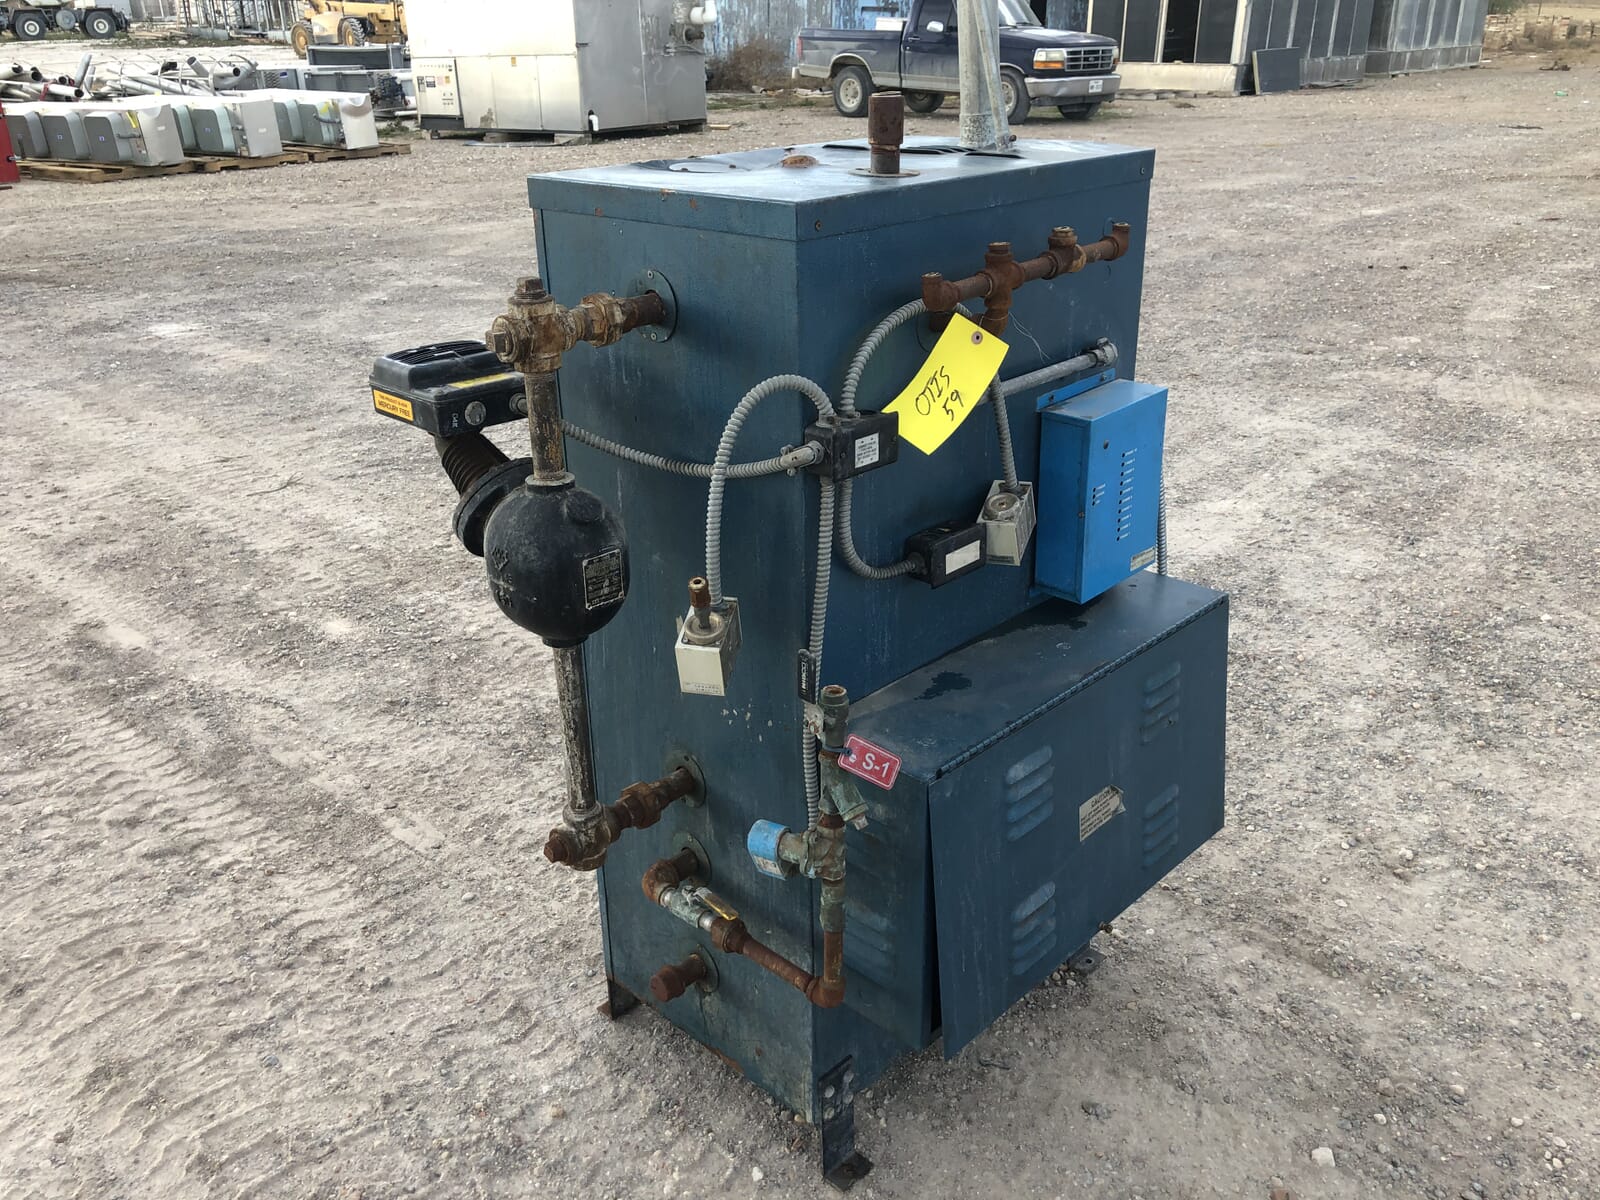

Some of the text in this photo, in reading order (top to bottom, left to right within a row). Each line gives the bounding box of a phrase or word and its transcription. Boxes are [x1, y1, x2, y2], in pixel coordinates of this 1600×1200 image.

[915, 366, 949, 415] OTIS
[942, 389, 964, 421] 59
[862, 753, 890, 778] S-1
